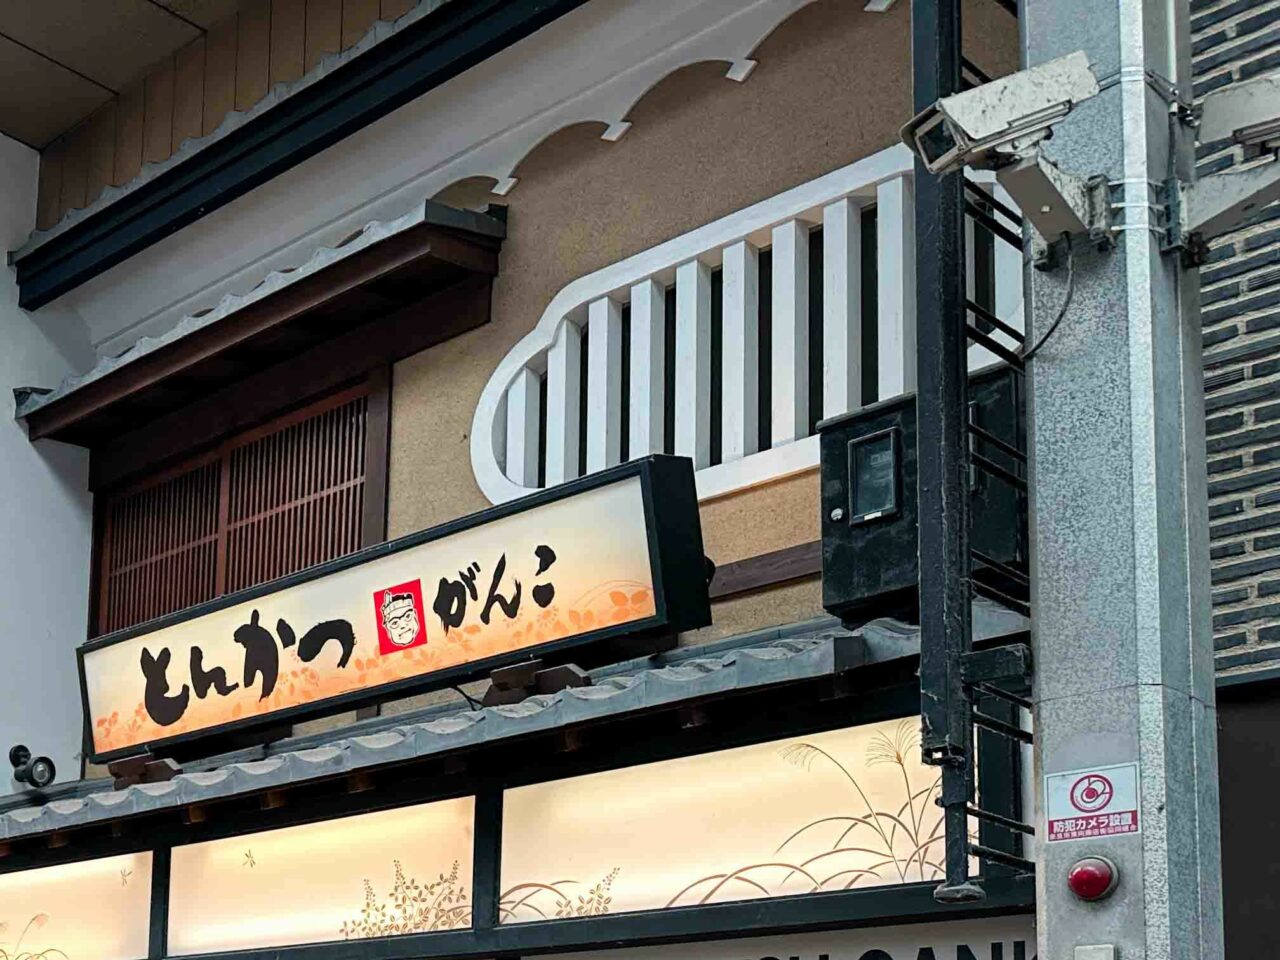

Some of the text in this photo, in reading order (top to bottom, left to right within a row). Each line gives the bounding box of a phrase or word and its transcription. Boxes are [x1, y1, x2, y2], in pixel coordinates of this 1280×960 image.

[140, 544, 556, 727] とんかつ がんこ
[1053, 812, 1132, 834] 防犯カメラ設置
